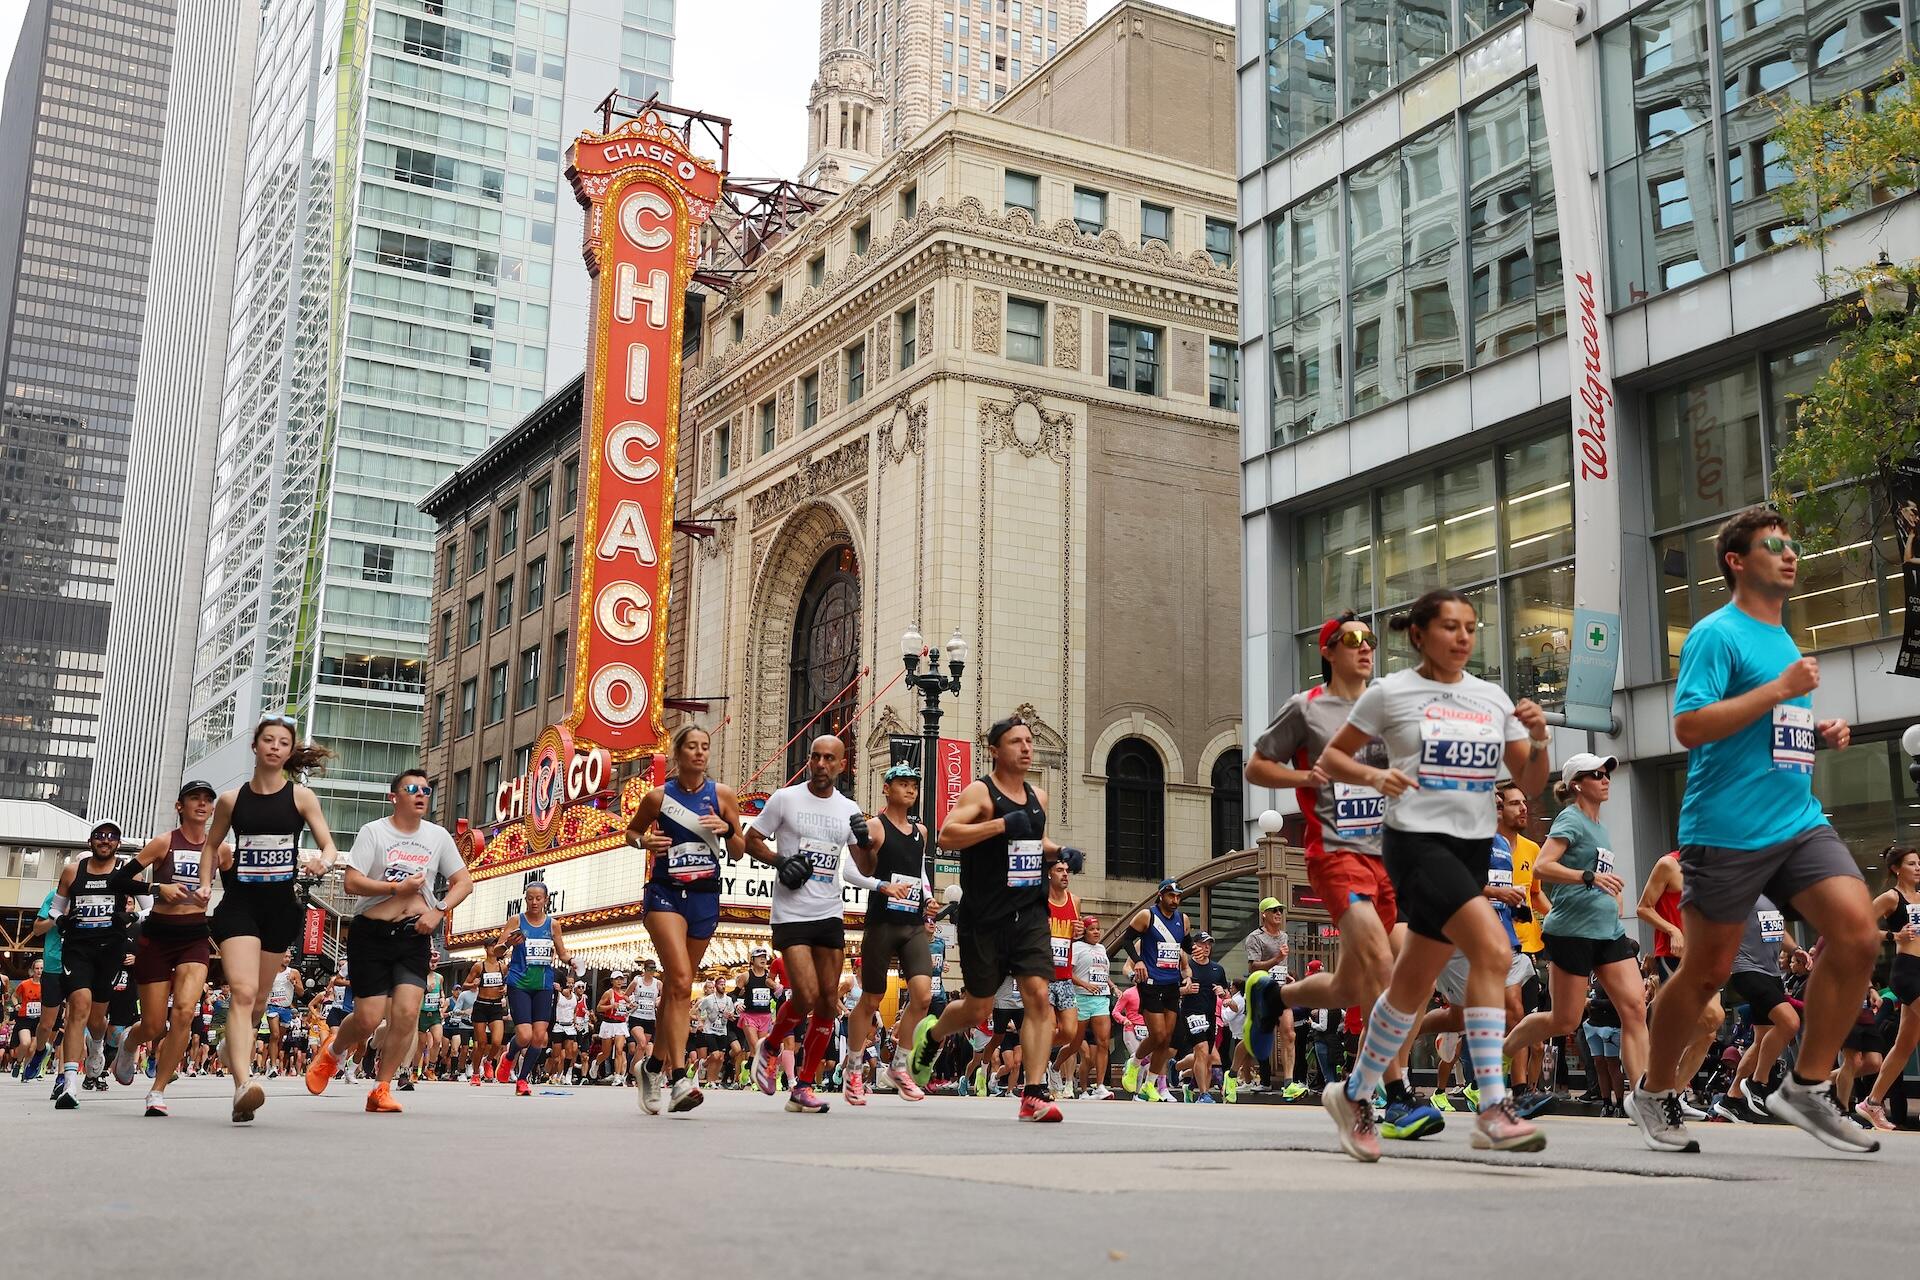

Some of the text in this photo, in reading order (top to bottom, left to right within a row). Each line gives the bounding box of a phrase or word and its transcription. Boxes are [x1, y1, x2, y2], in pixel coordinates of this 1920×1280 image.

[603, 143, 676, 167] CHASE
[1576, 270, 1613, 482] Walgreens
[588, 191, 674, 728] CHICAGO
[1442, 692, 1453, 700] OF
[1424, 703, 1494, 724] Chicago
[1775, 727, 1785, 746] E
[1424, 741, 1500, 767] E 4950
[495, 748, 603, 823] CHICAGO
[667, 806, 686, 817] CHI
[1337, 801, 1347, 817] C
[797, 812, 843, 831] PROTECT
[240, 850, 292, 865] E 15839
[387, 848, 431, 866] Chicago
[669, 858, 678, 868] D
[1009, 859, 1017, 869] E
[175, 863, 199, 877] E 12
[86, 905, 114, 917] 7134
[1761, 921, 1768, 931] E
[526, 948, 533, 957] E
